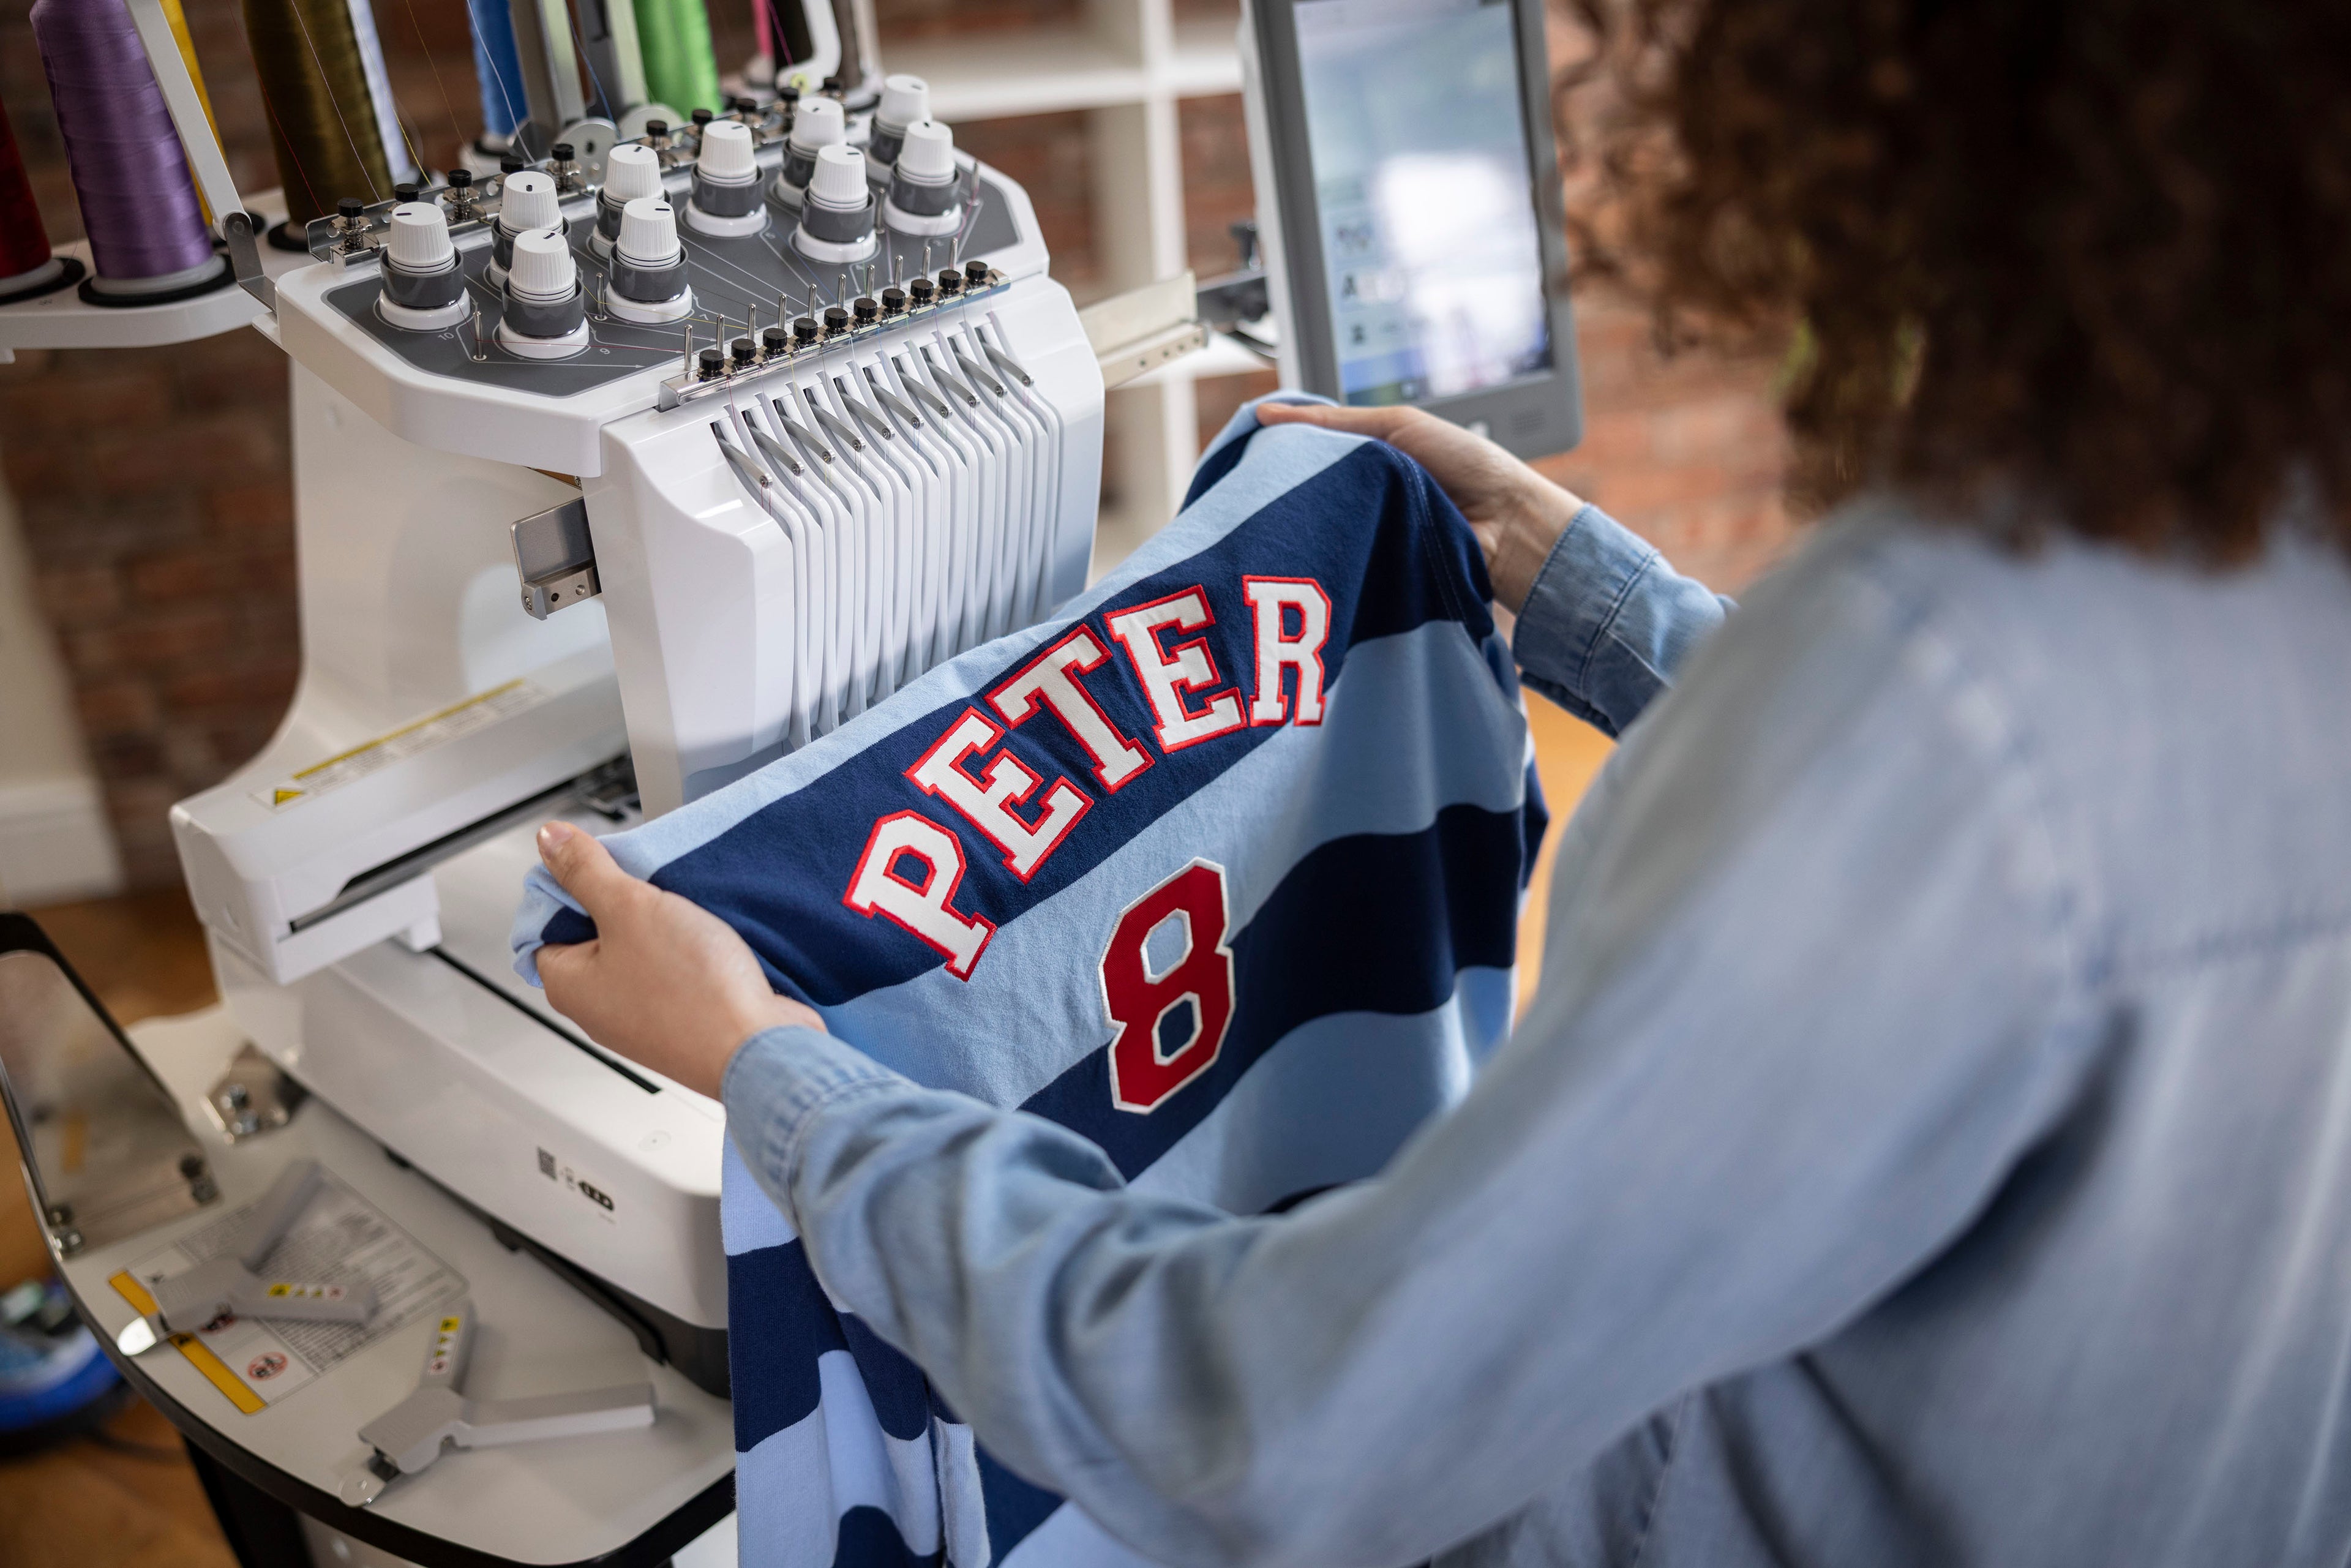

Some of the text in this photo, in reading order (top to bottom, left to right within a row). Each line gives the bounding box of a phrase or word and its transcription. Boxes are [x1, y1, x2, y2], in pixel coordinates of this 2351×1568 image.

[437, 332, 454, 340] 10
[842, 574, 1332, 981] PETER
[1098, 856, 1236, 1116] 8
